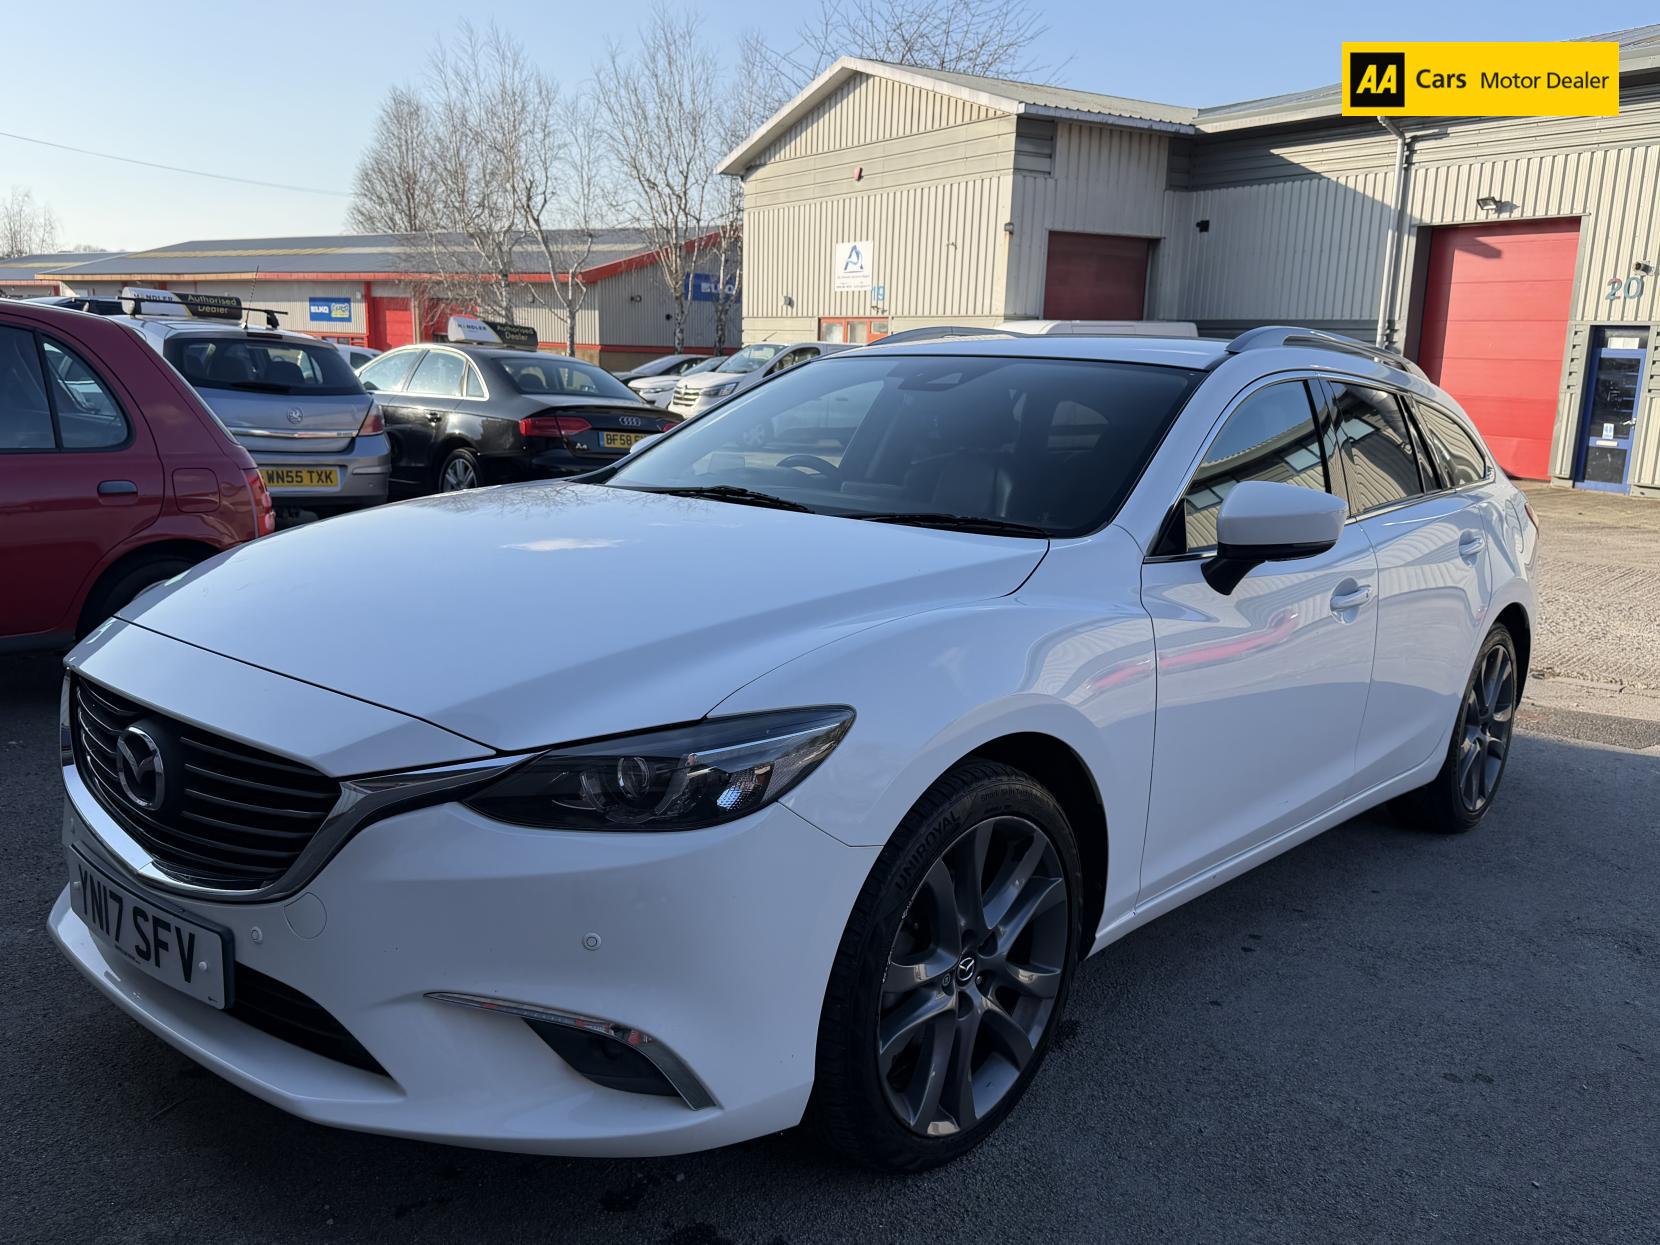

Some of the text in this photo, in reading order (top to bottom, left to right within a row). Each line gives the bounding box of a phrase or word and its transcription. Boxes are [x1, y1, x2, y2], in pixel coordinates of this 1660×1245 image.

[1605, 277, 1643, 300] 20
[188, 294, 237, 305] Authorised
[505, 332, 528, 341] Dealer
[605, 433, 632, 445] BF58
[266, 470, 333, 484] WN55 TXK
[895, 810, 960, 890] UNIROYAL
[78, 863, 195, 984] YN17 SFV
